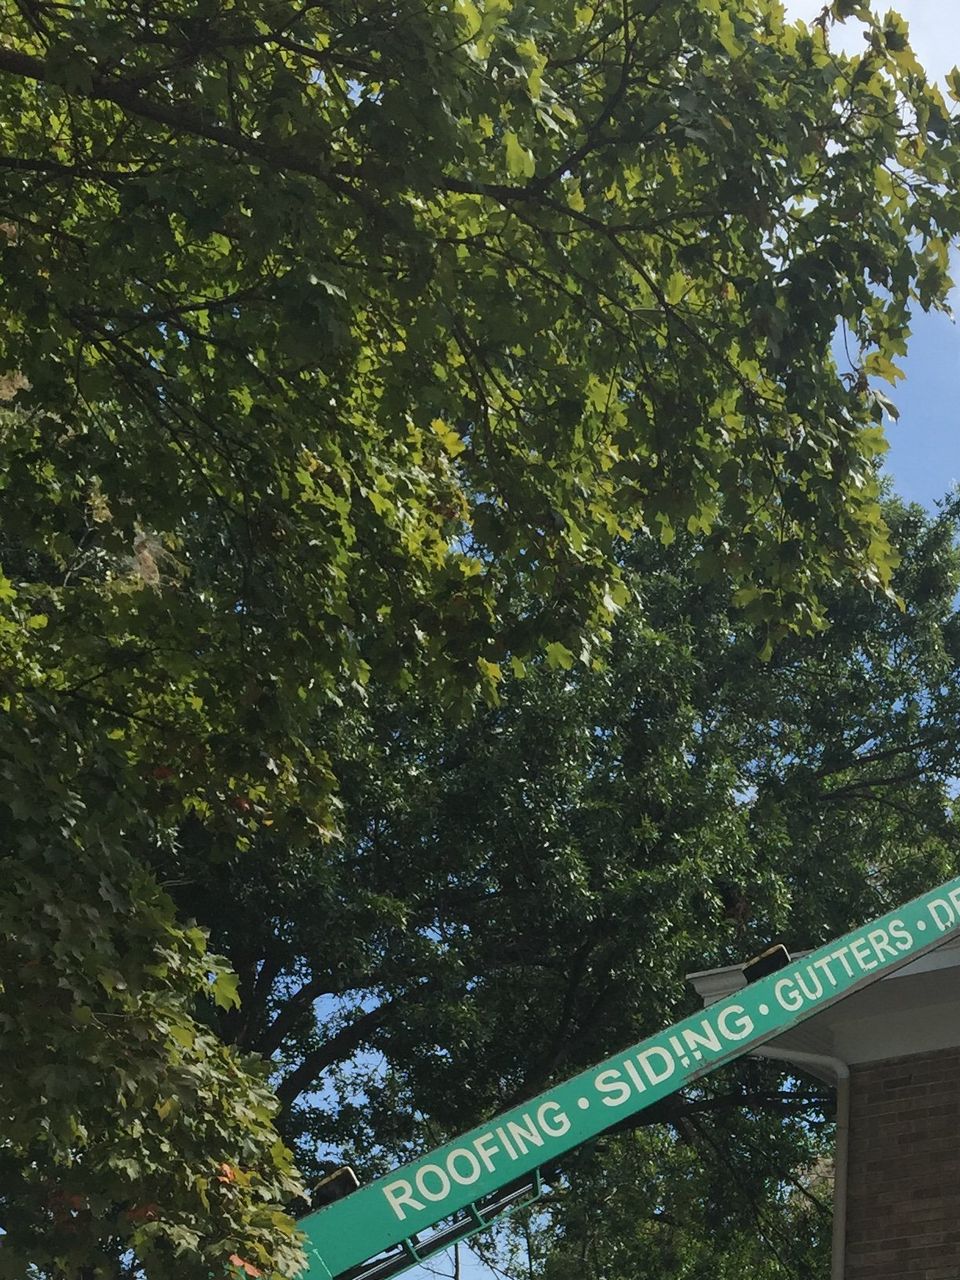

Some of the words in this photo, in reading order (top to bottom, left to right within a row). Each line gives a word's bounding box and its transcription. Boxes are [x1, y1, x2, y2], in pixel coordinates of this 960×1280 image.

[382, 1101, 570, 1221] ROOFING
[593, 1005, 754, 1107] SIDING
[774, 919, 913, 1011] GUTTERS
